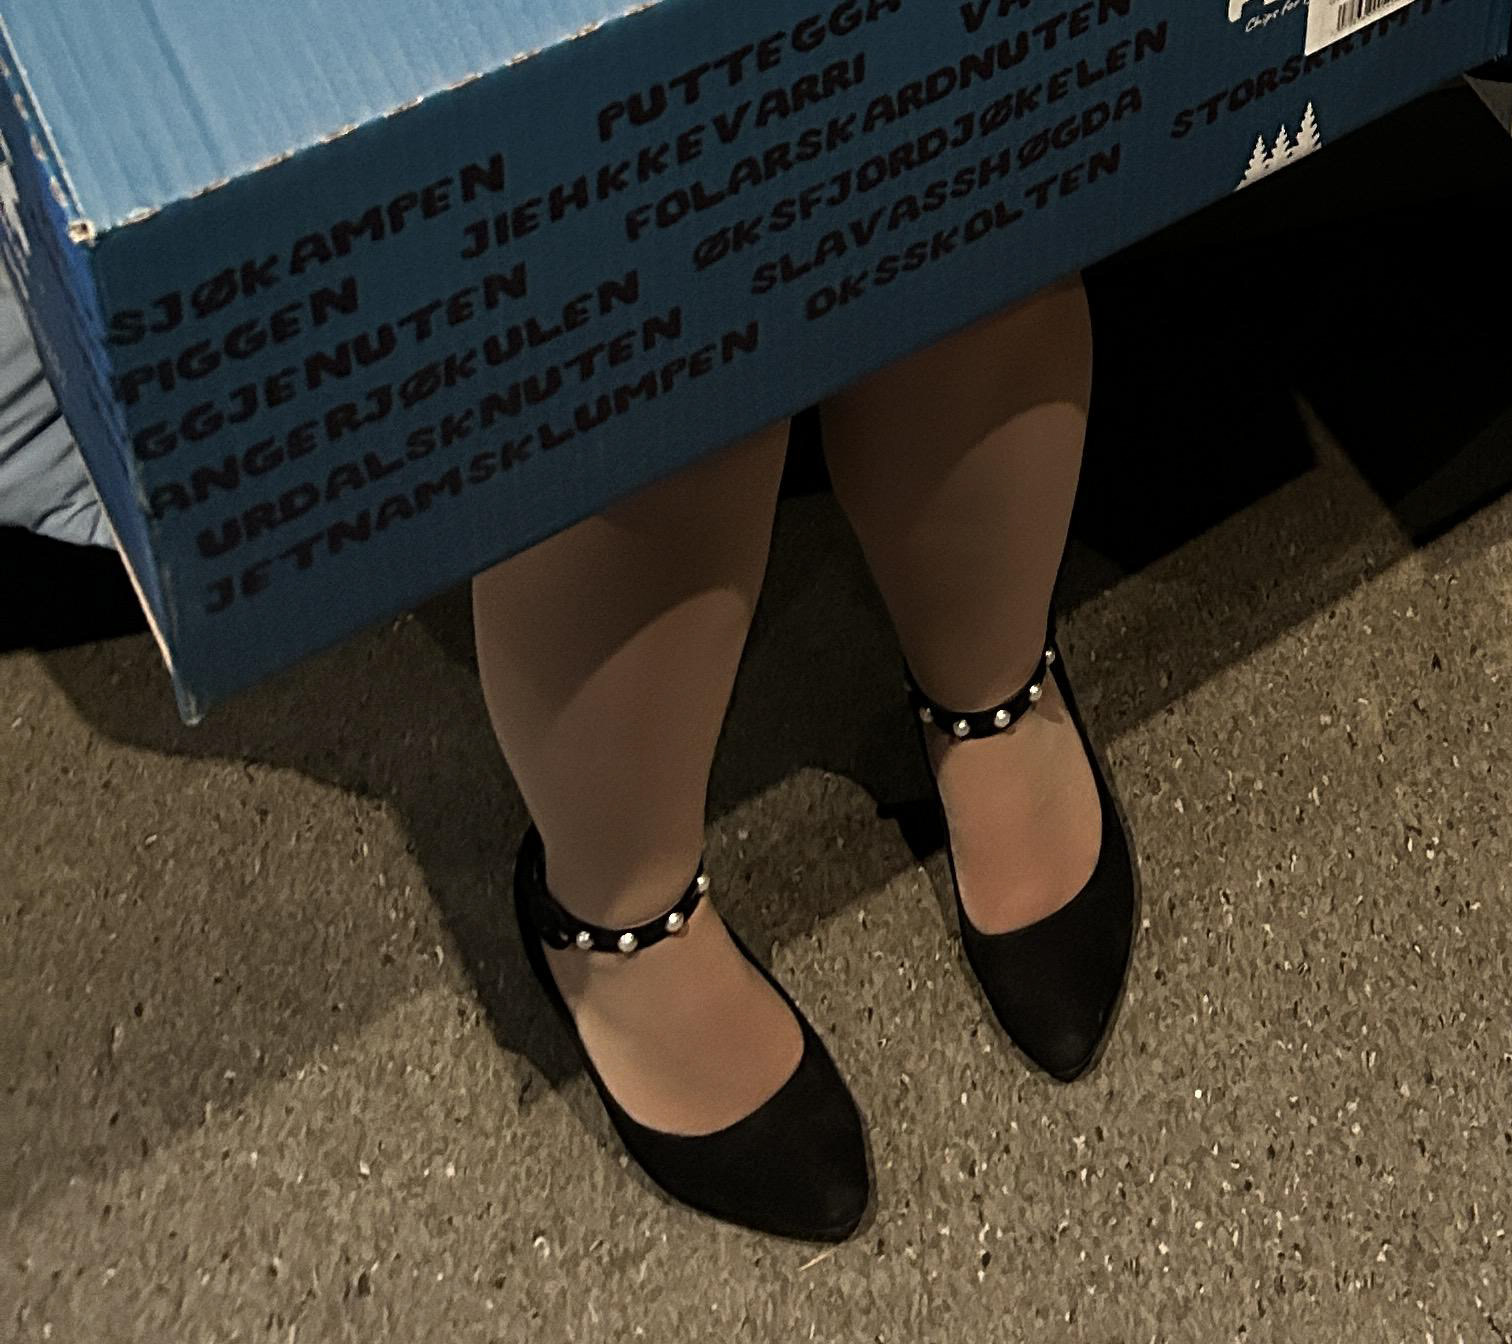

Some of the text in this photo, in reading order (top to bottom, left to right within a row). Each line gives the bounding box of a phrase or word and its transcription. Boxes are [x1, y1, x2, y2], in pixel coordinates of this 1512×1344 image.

[106, 152, 507, 346] SJØKAMPEN
[461, 52, 866, 260] JIEHKKEVARRI
[693, 20, 1169, 272] ØKSFJORDJØKELEN
[751, 87, 1143, 296] SLAVASSHØGDA
[804, 142, 1122, 322] OKSSKOLTEN
[117, 275, 360, 405] PIGGEN
[133, 262, 529, 461] GGJENUTEN
[149, 269, 641, 519] ANGERJØKULEN
[197, 306, 684, 558] URDALSKNUTEN
[204, 321, 760, 614] JETNAMSKLUMPEN
